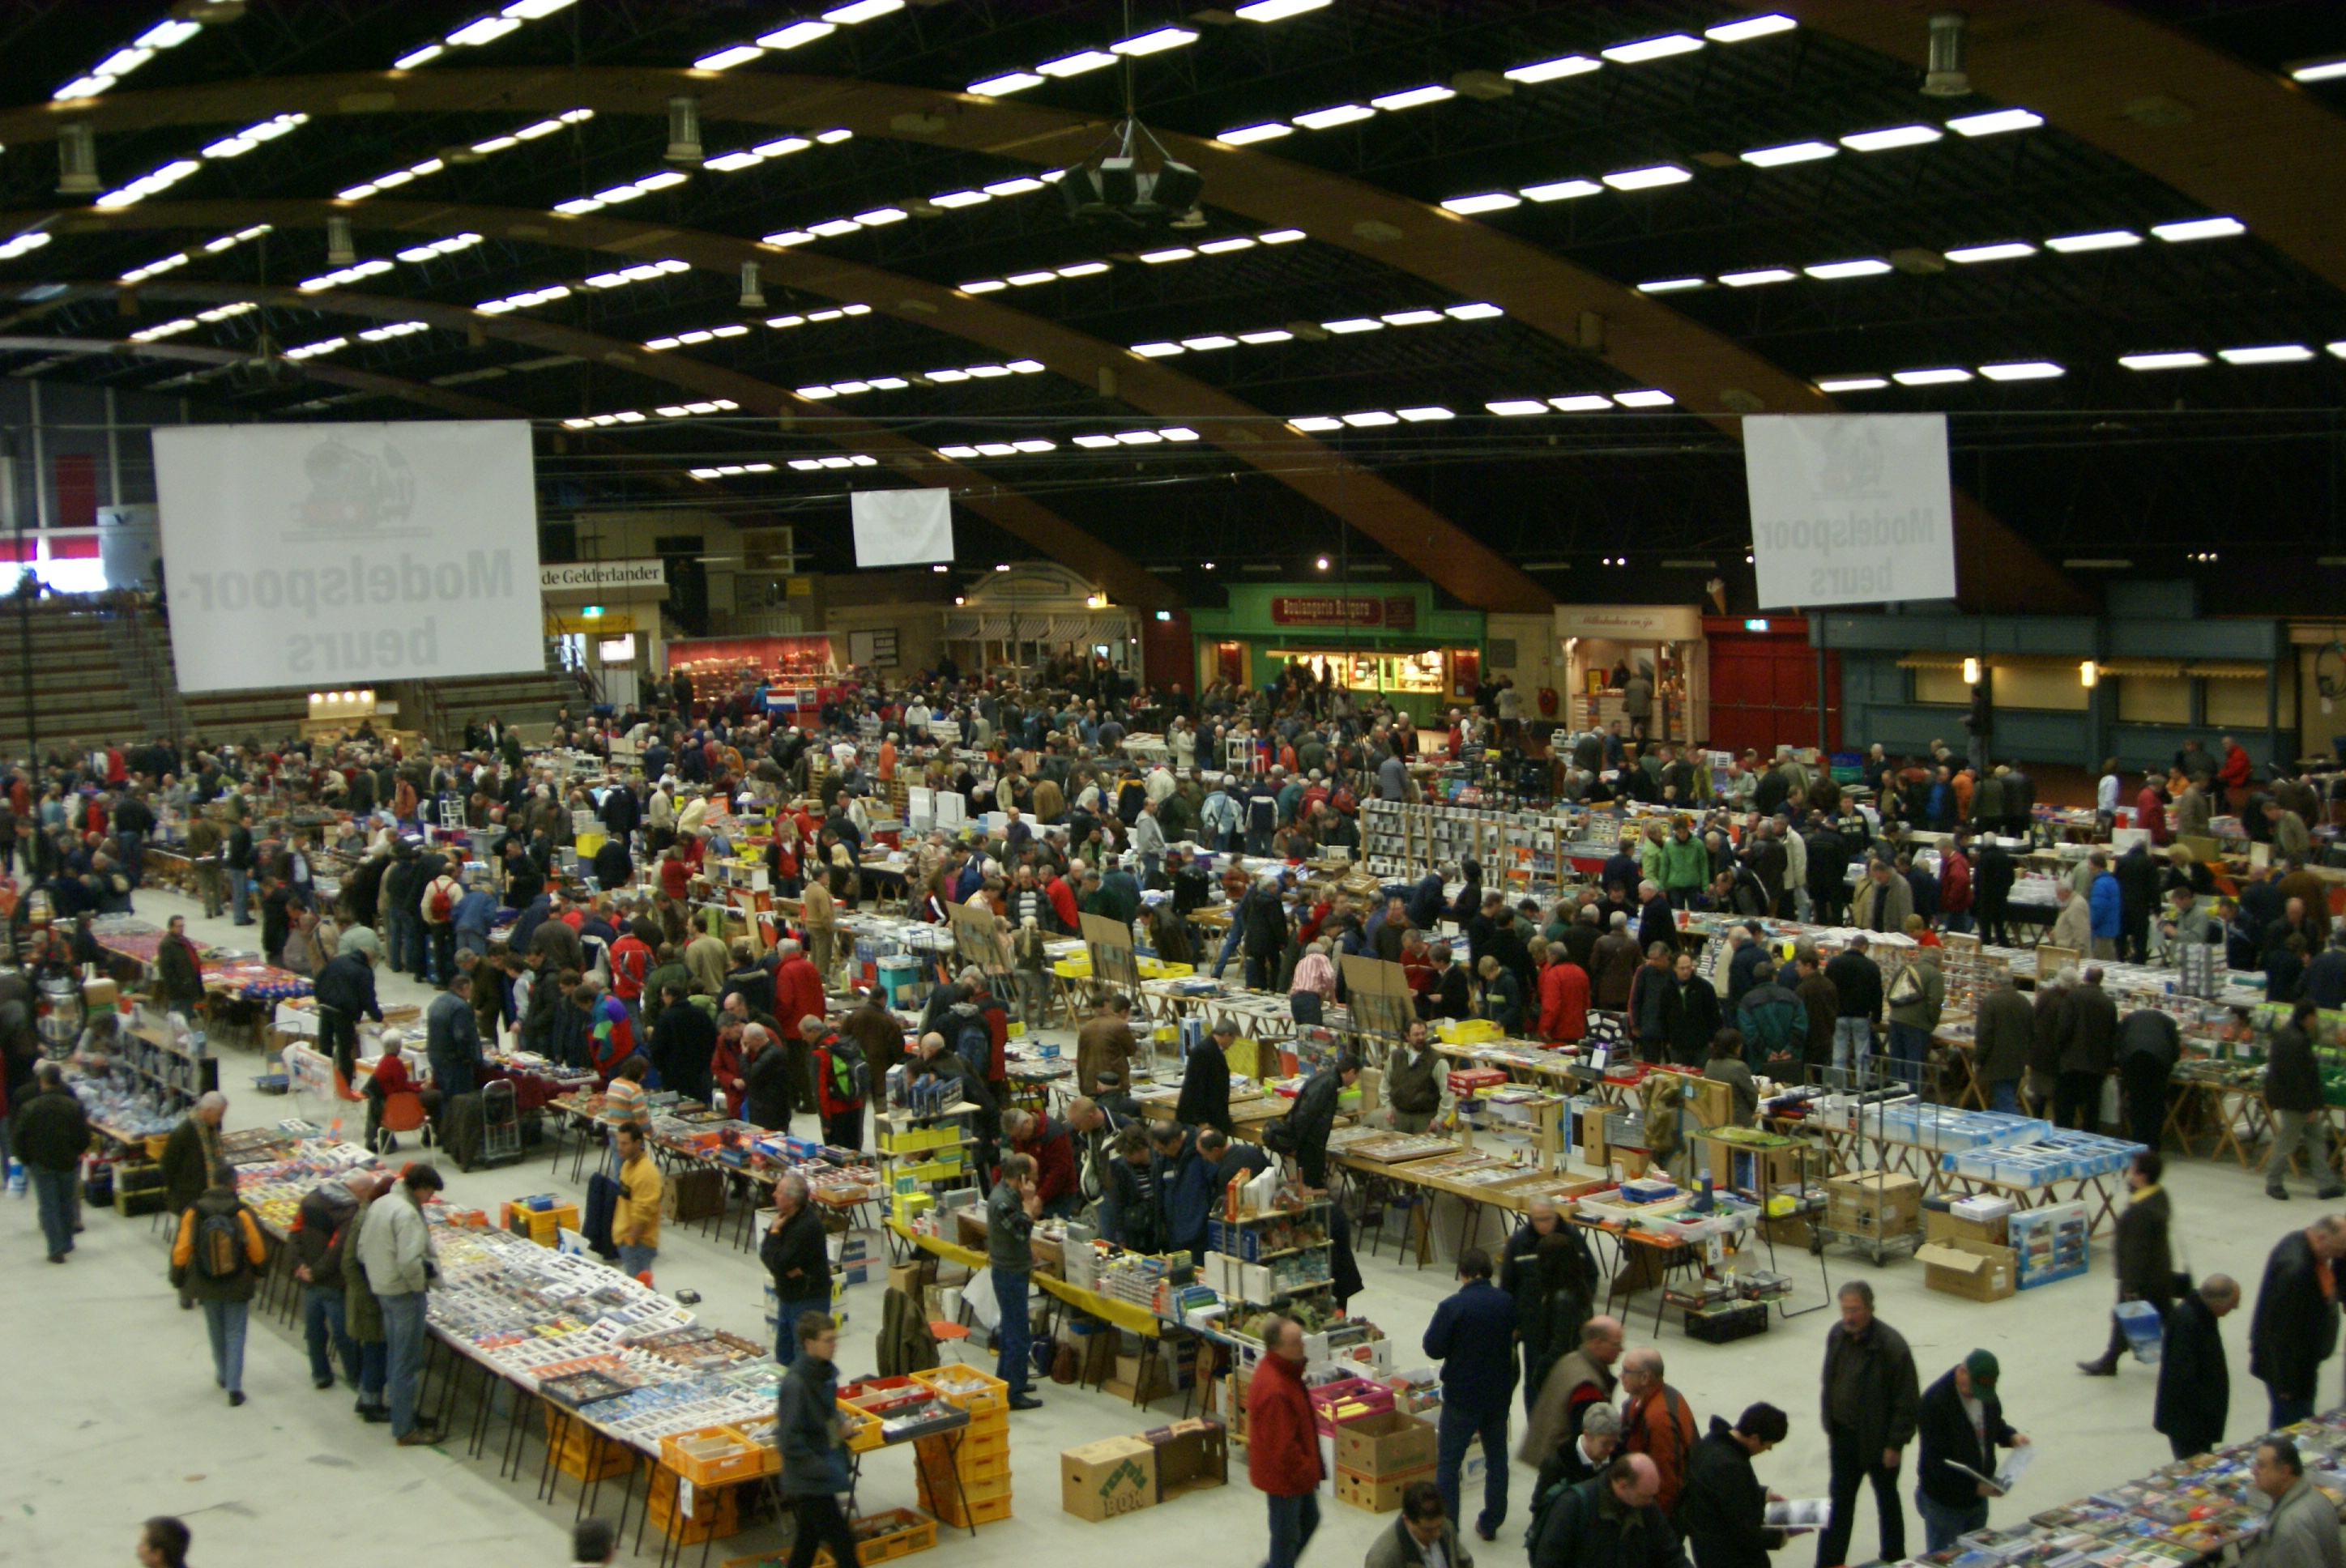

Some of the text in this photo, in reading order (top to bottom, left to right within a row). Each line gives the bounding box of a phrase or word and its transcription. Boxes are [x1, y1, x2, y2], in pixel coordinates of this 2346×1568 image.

[542, 567, 659, 585] de Gelderlander
[1103, 1489, 1144, 1518] BOX
